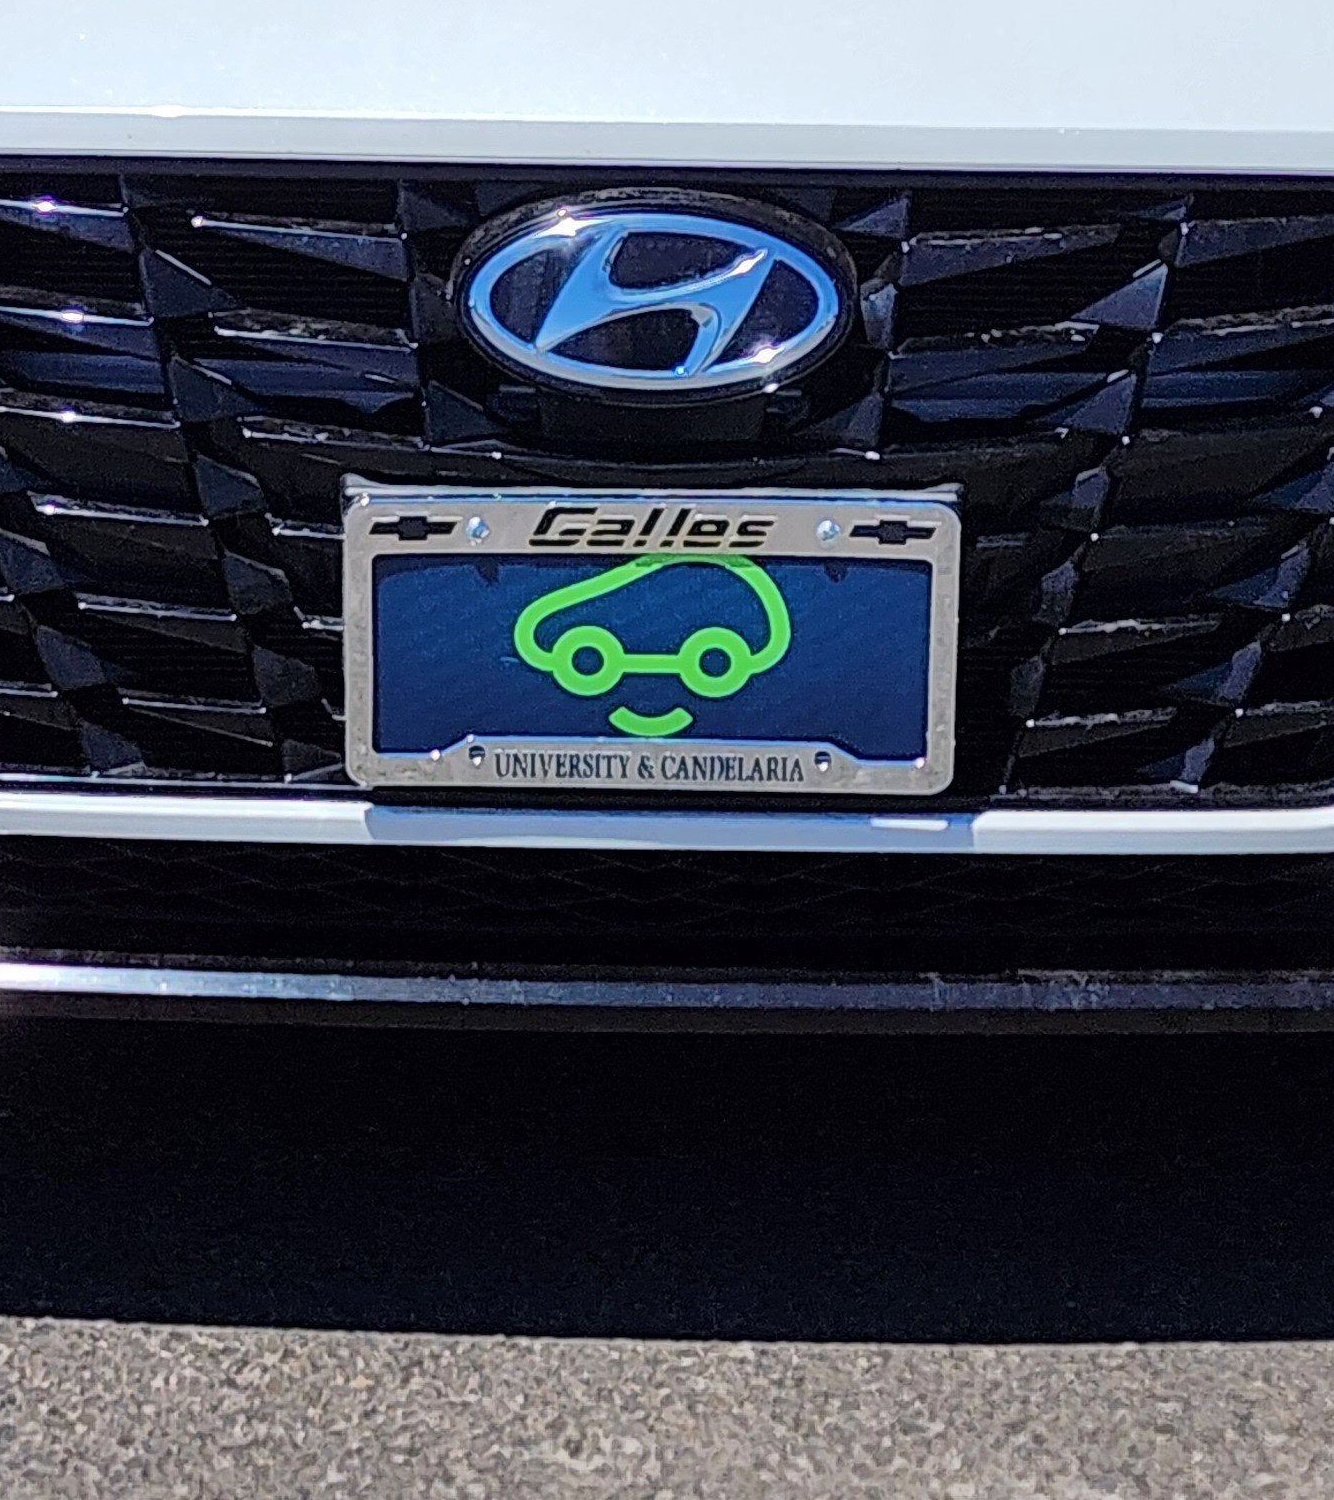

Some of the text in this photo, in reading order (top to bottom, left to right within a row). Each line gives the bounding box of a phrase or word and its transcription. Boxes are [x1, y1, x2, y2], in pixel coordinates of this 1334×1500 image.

[528, 505, 775, 548] Galles
[494, 751, 805, 783] UNIVERSITY & CANDELARIA
